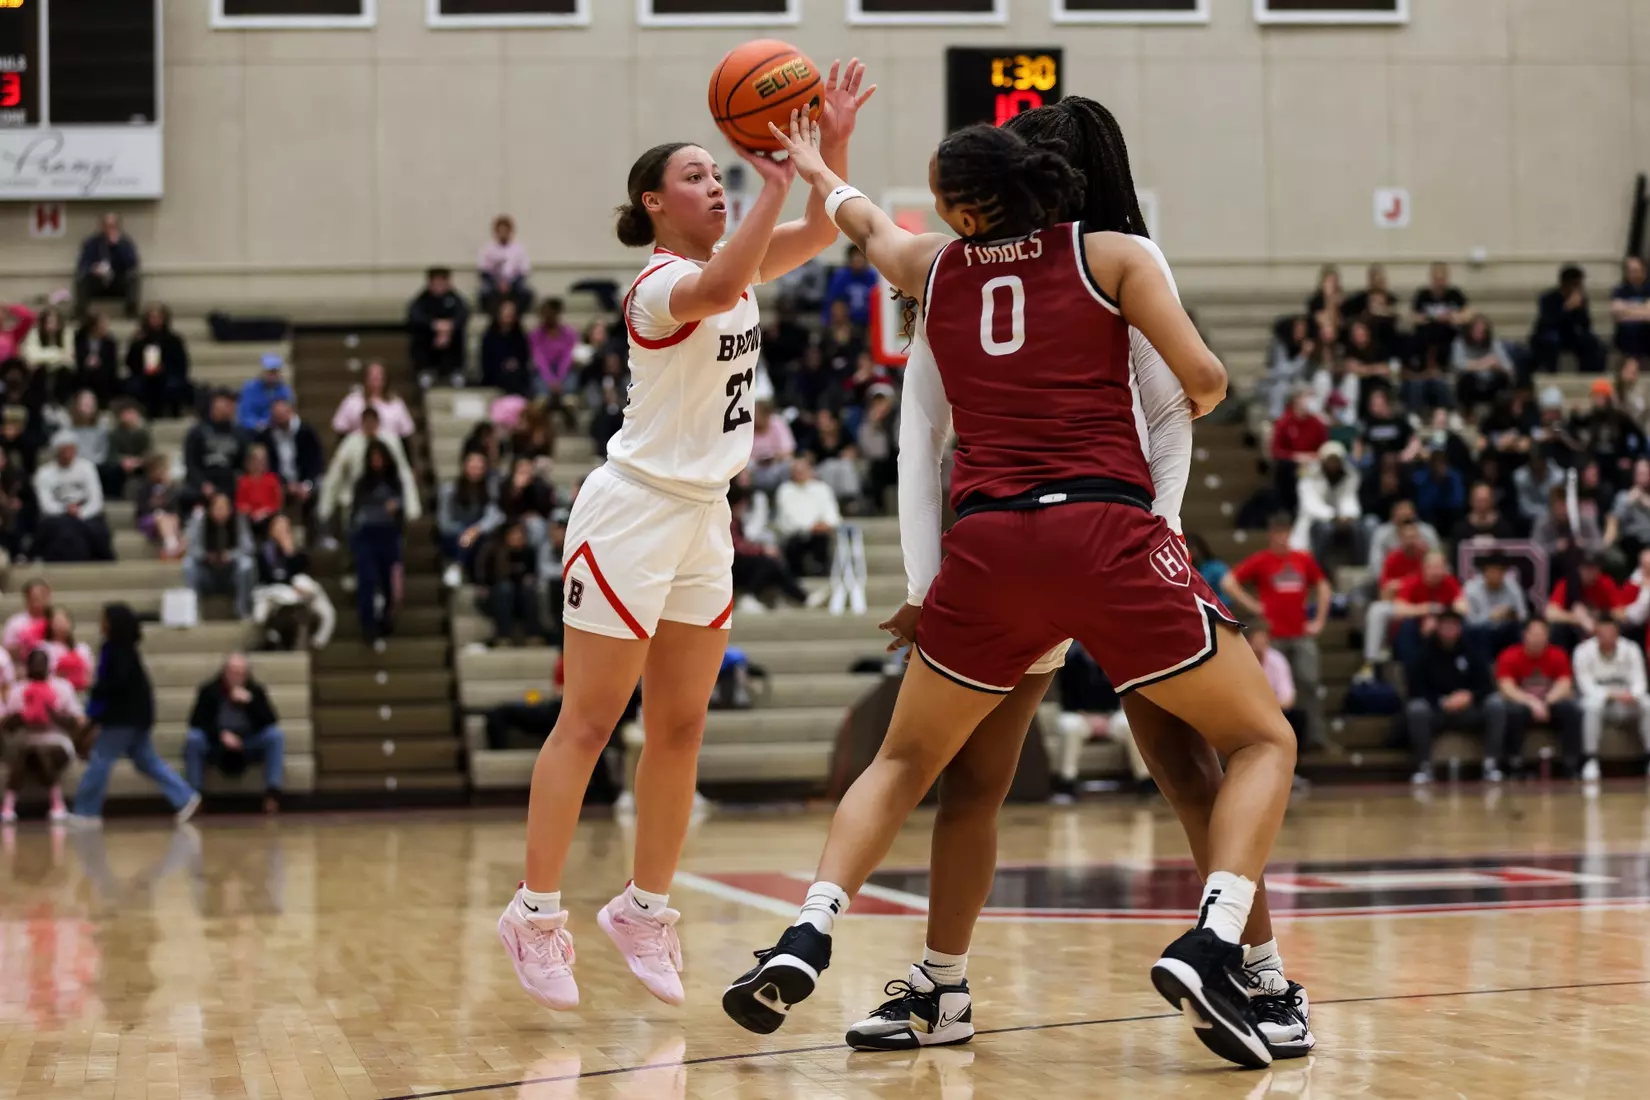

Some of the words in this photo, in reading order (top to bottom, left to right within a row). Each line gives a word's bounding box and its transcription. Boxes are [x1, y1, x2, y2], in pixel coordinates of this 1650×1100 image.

[752, 58, 811, 99] ELITE
[991, 55, 1056, 91] 1:30
[1384, 197, 1402, 221] J
[980, 275, 1026, 356] 0
[1155, 546, 1184, 578] H
[568, 576, 584, 609] B
